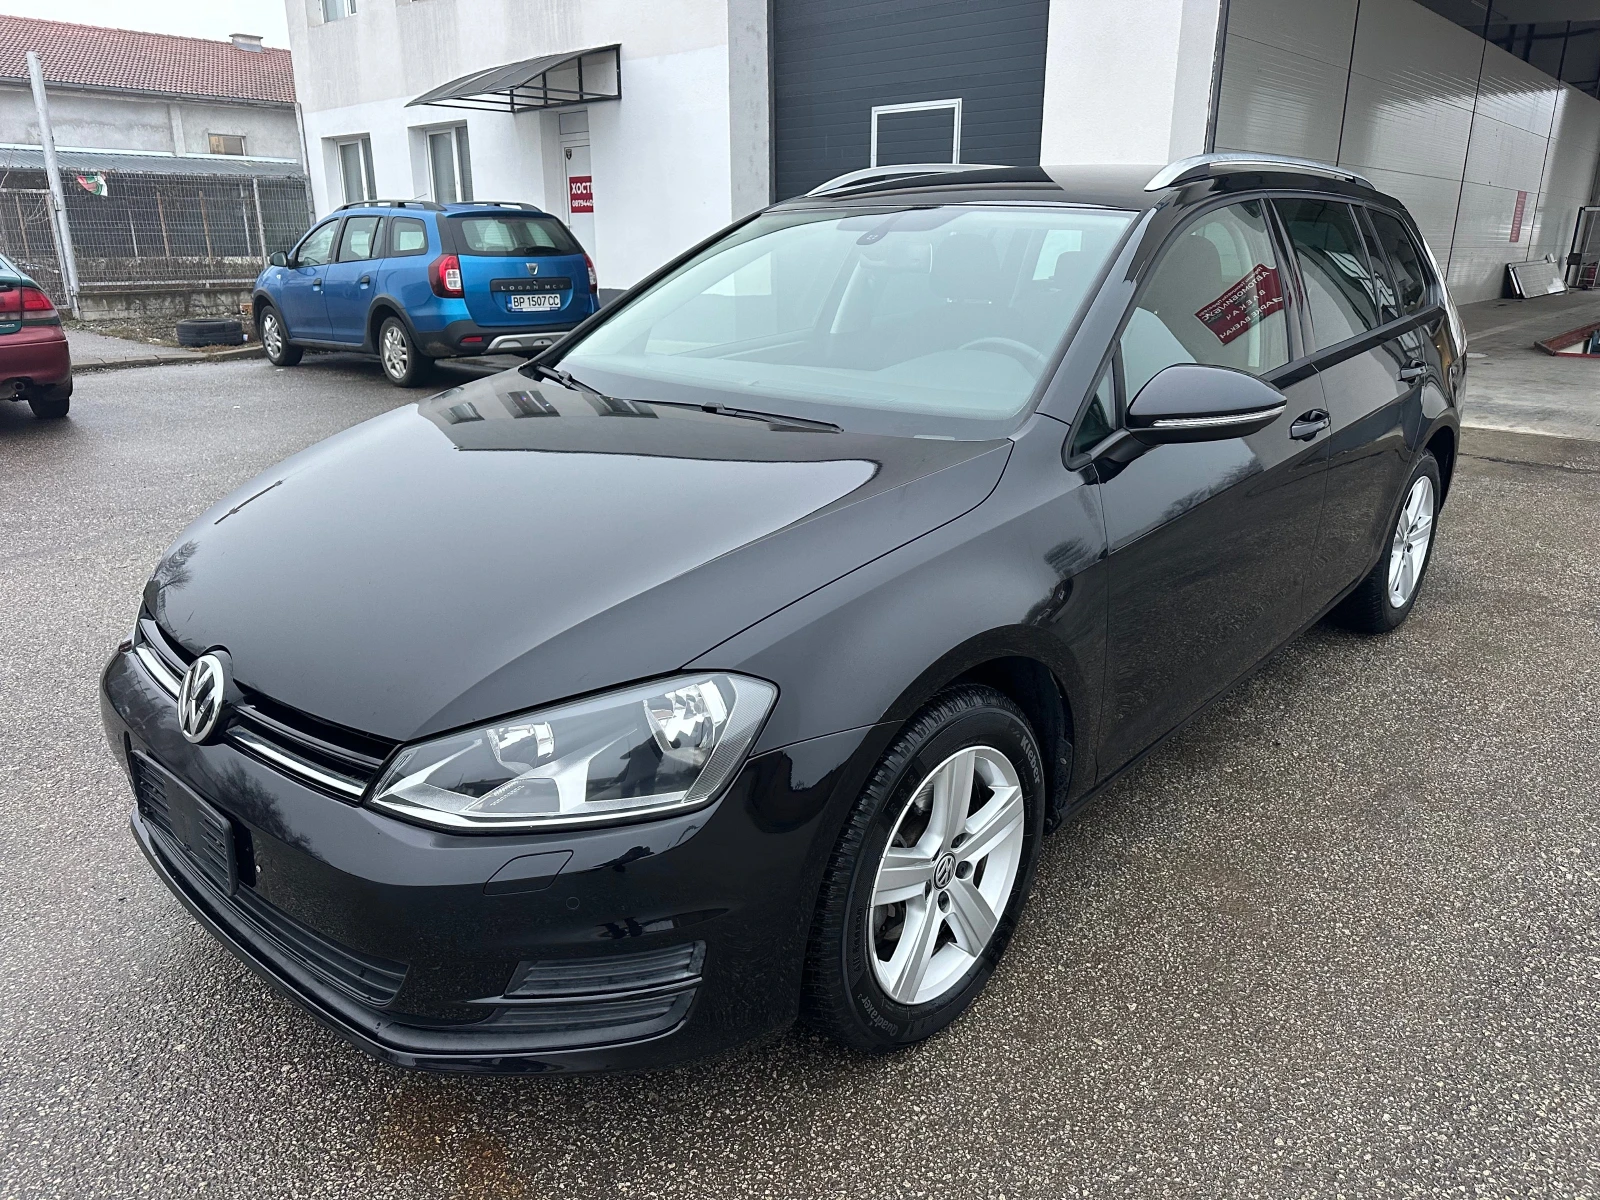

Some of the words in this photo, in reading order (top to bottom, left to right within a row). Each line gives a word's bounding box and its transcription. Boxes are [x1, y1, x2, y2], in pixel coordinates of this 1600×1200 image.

[571, 182, 593, 194] ХОСТ
[513, 296, 525, 307] BP
[527, 295, 547, 307] 1507
[547, 295, 559, 306] CC
[1020, 735, 1040, 784] Kleber
